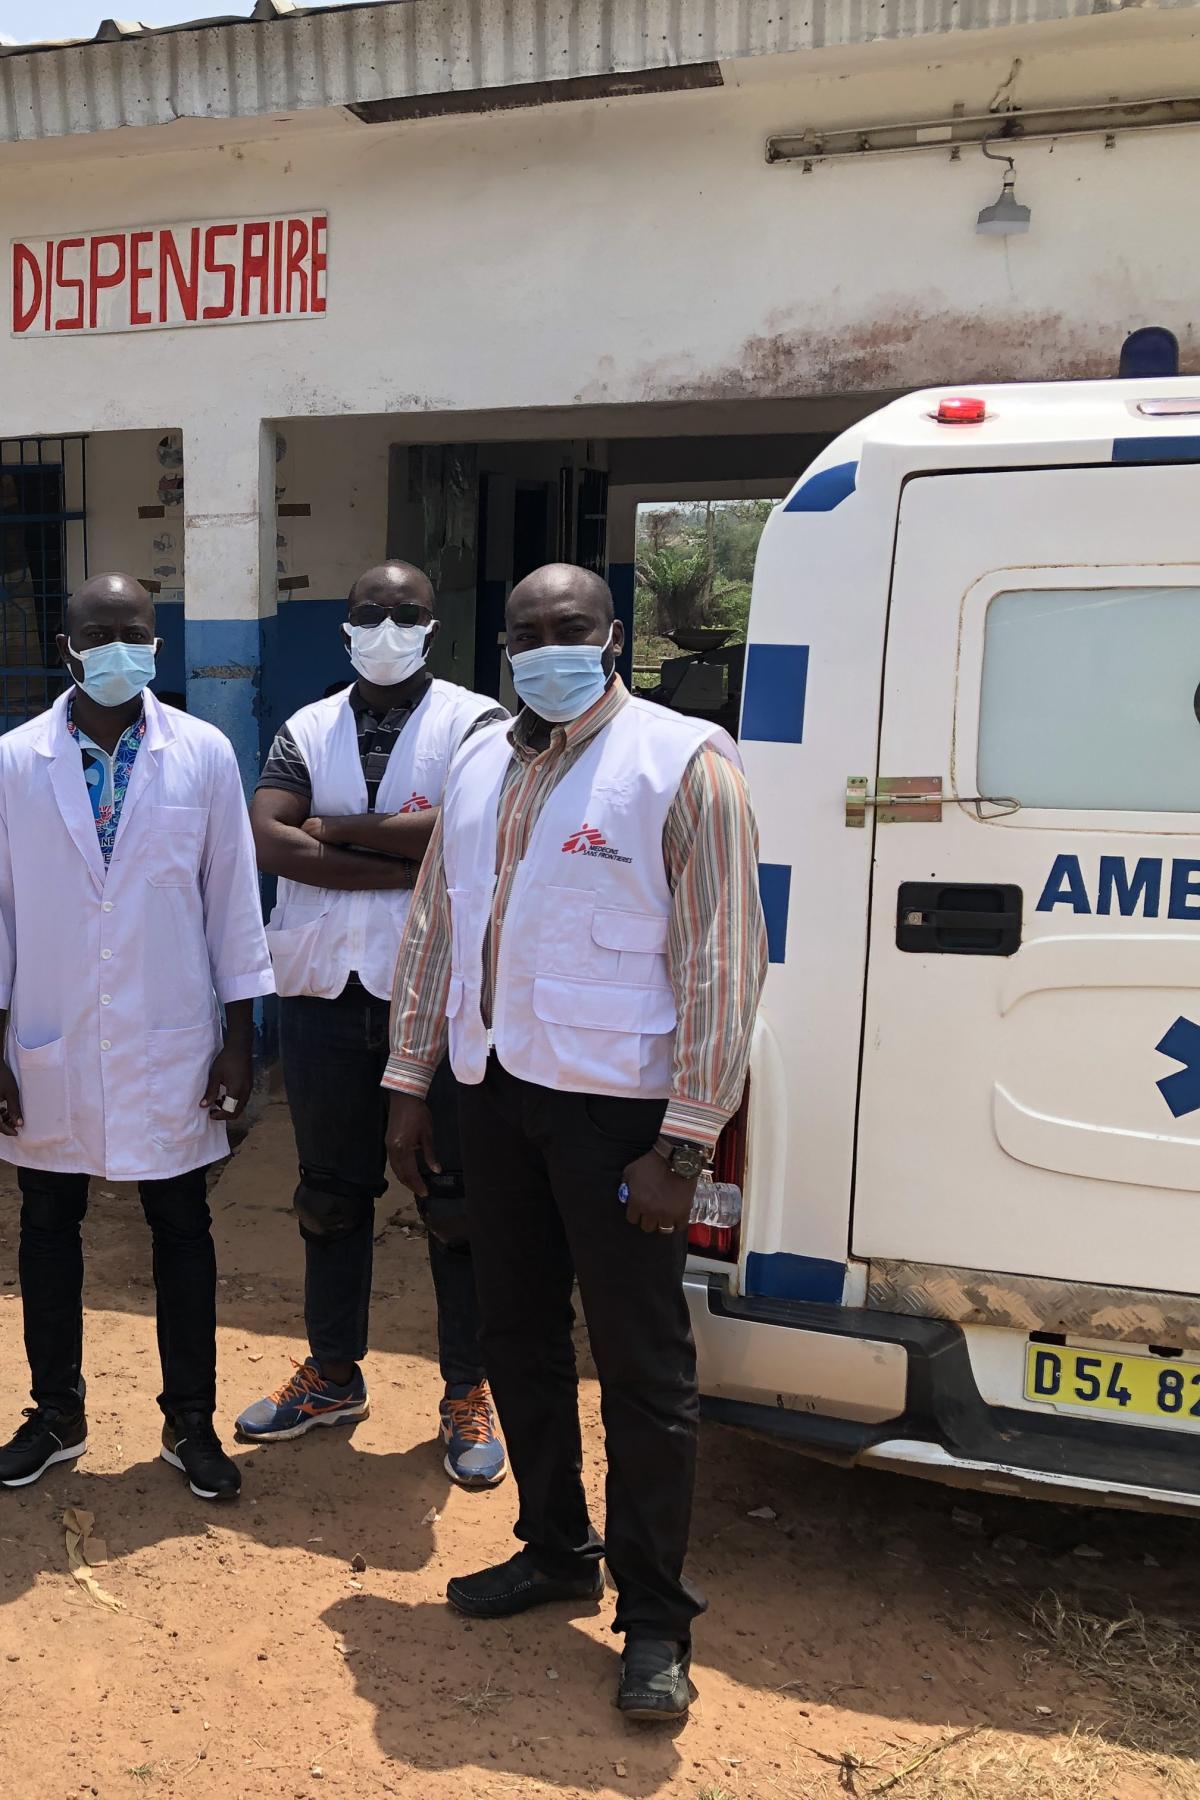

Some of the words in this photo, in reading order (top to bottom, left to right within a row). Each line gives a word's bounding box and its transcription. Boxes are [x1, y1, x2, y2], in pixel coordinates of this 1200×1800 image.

[13, 216, 327, 332] DISPENSAIRE
[1035, 854, 1200, 921] AMB
[1034, 1351, 1062, 1396] D
[1074, 1356, 1132, 1407] 54
